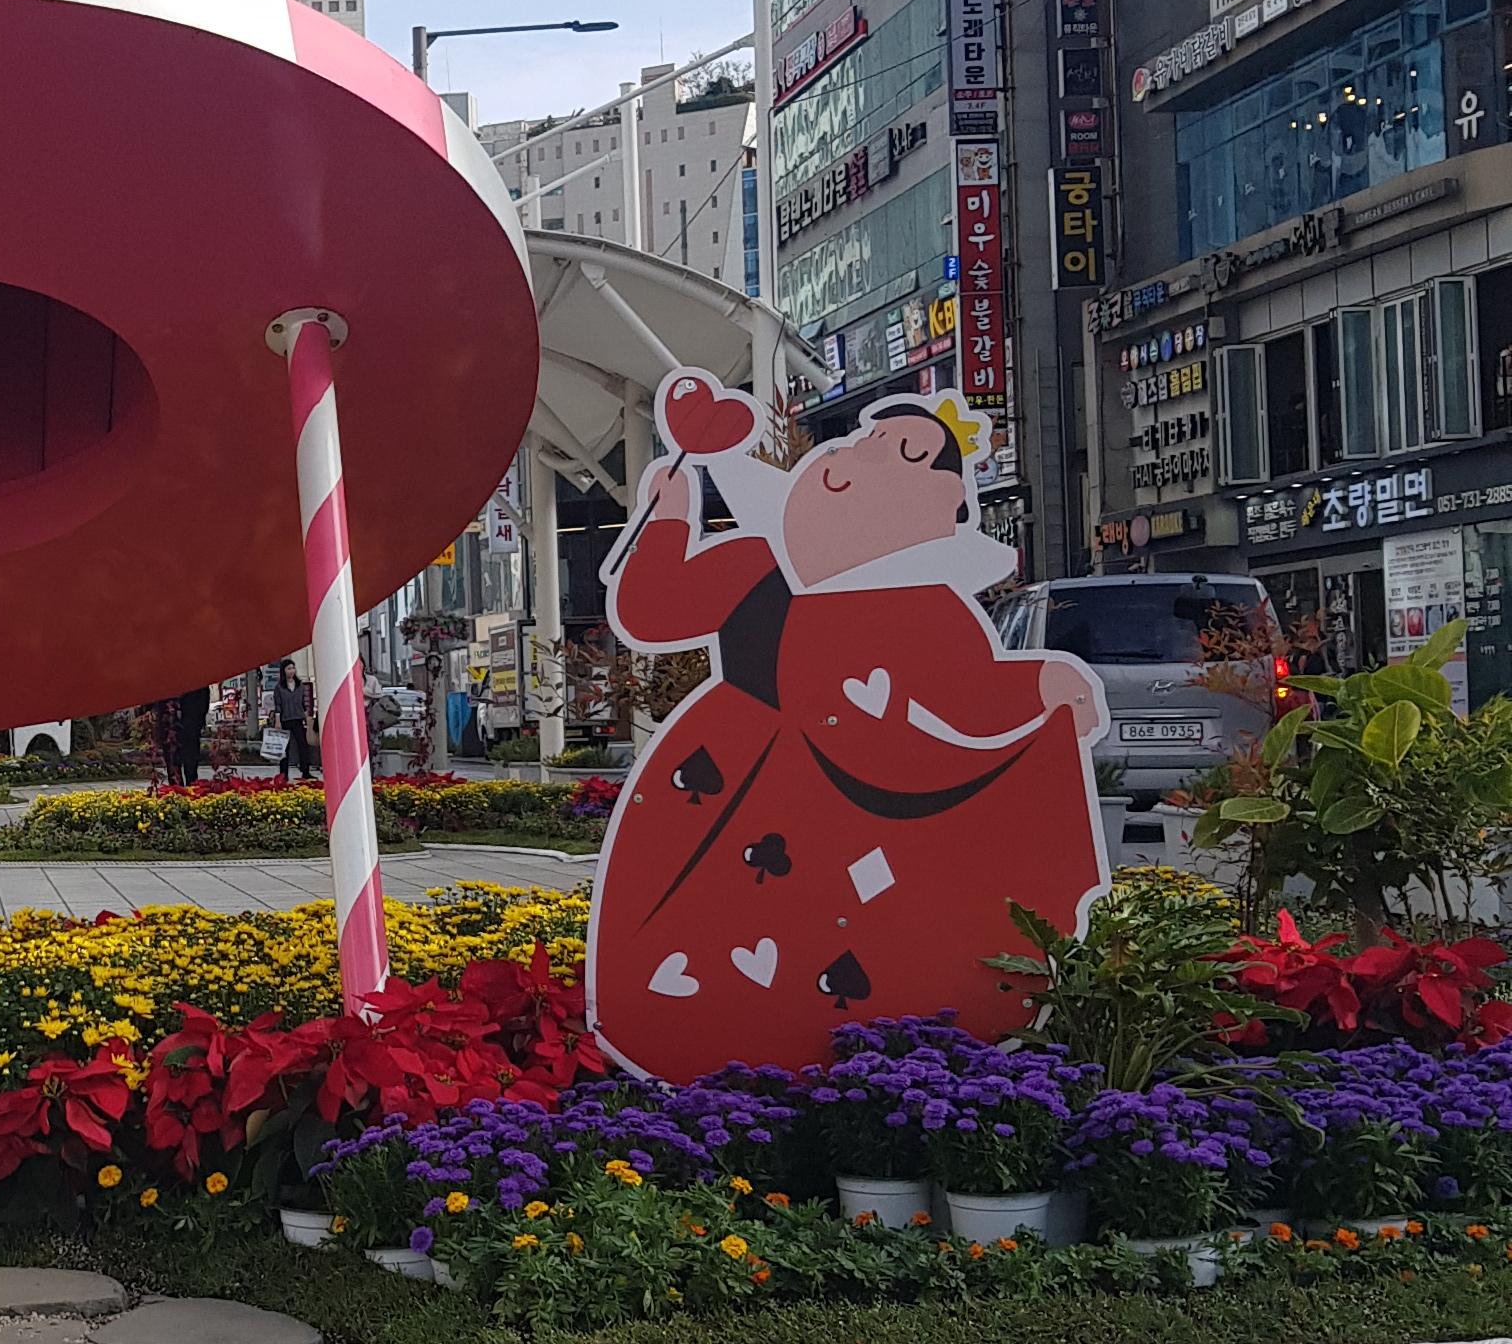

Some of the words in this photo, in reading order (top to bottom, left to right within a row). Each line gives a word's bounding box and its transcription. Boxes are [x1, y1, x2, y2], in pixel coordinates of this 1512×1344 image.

[1154, 15, 1232, 91] 유가네닭갈비
[1454, 90, 1486, 141] 유
[1060, 171, 1098, 282] 궁타이
[1137, 373, 1169, 406] 헤즈업
[1169, 361, 1204, 398] 홀덤펍
[1129, 464, 1153, 490] THAI
[1321, 467, 1434, 532] 초량밀면
